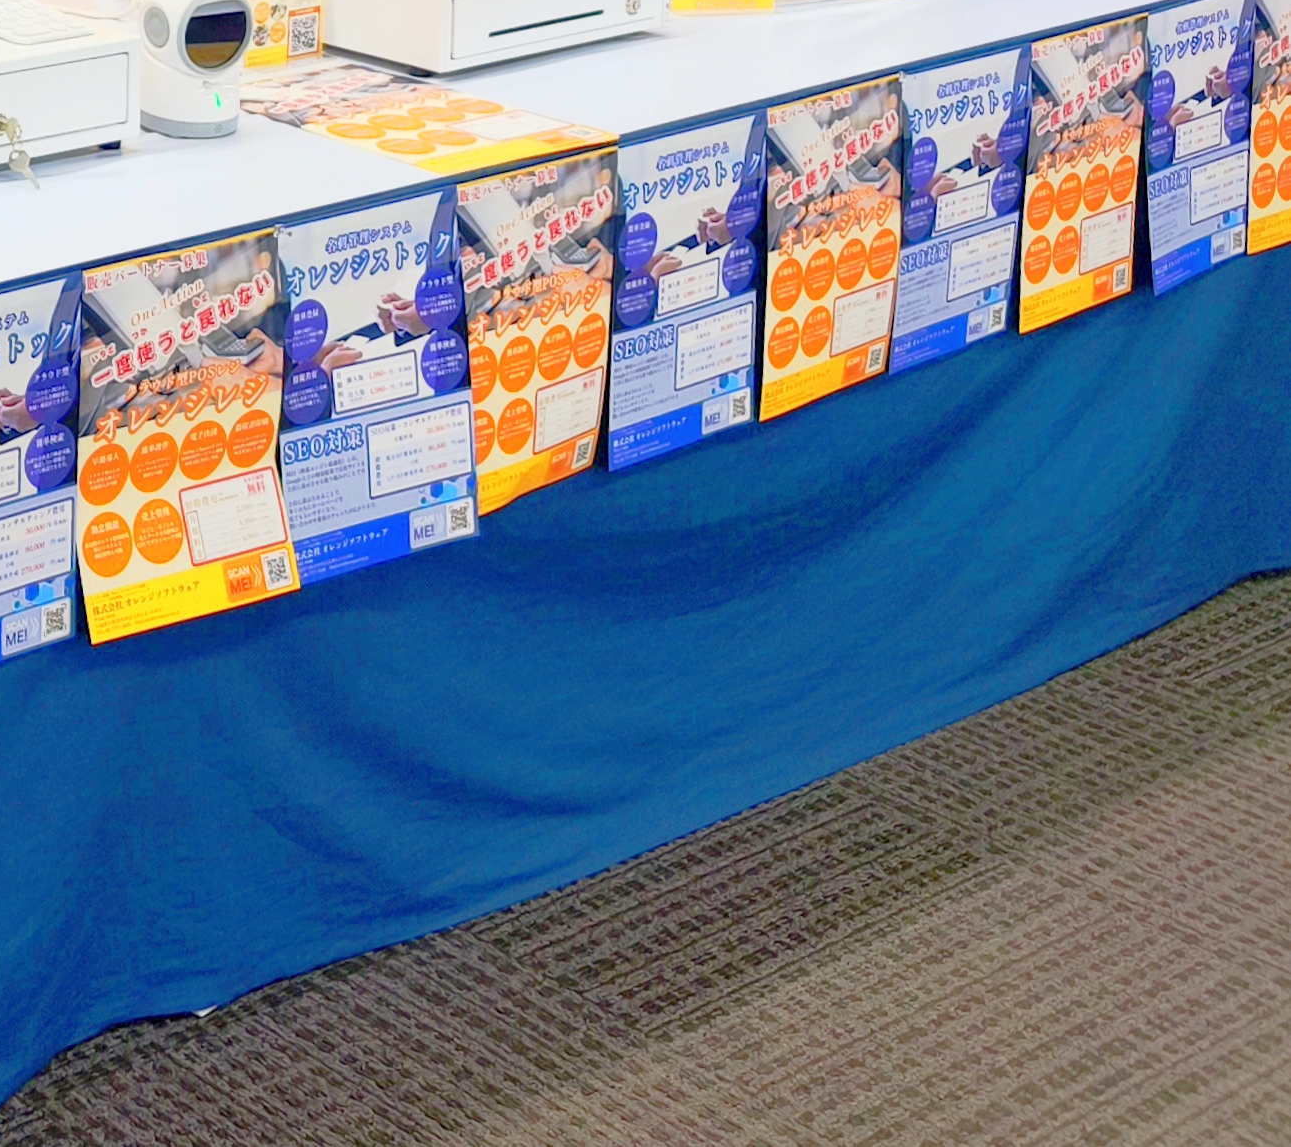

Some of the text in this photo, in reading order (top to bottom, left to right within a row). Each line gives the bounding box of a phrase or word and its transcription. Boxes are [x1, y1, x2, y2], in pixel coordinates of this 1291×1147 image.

[94, 368, 268, 446] オレンジレジ
[283, 421, 363, 467] SEO対策
